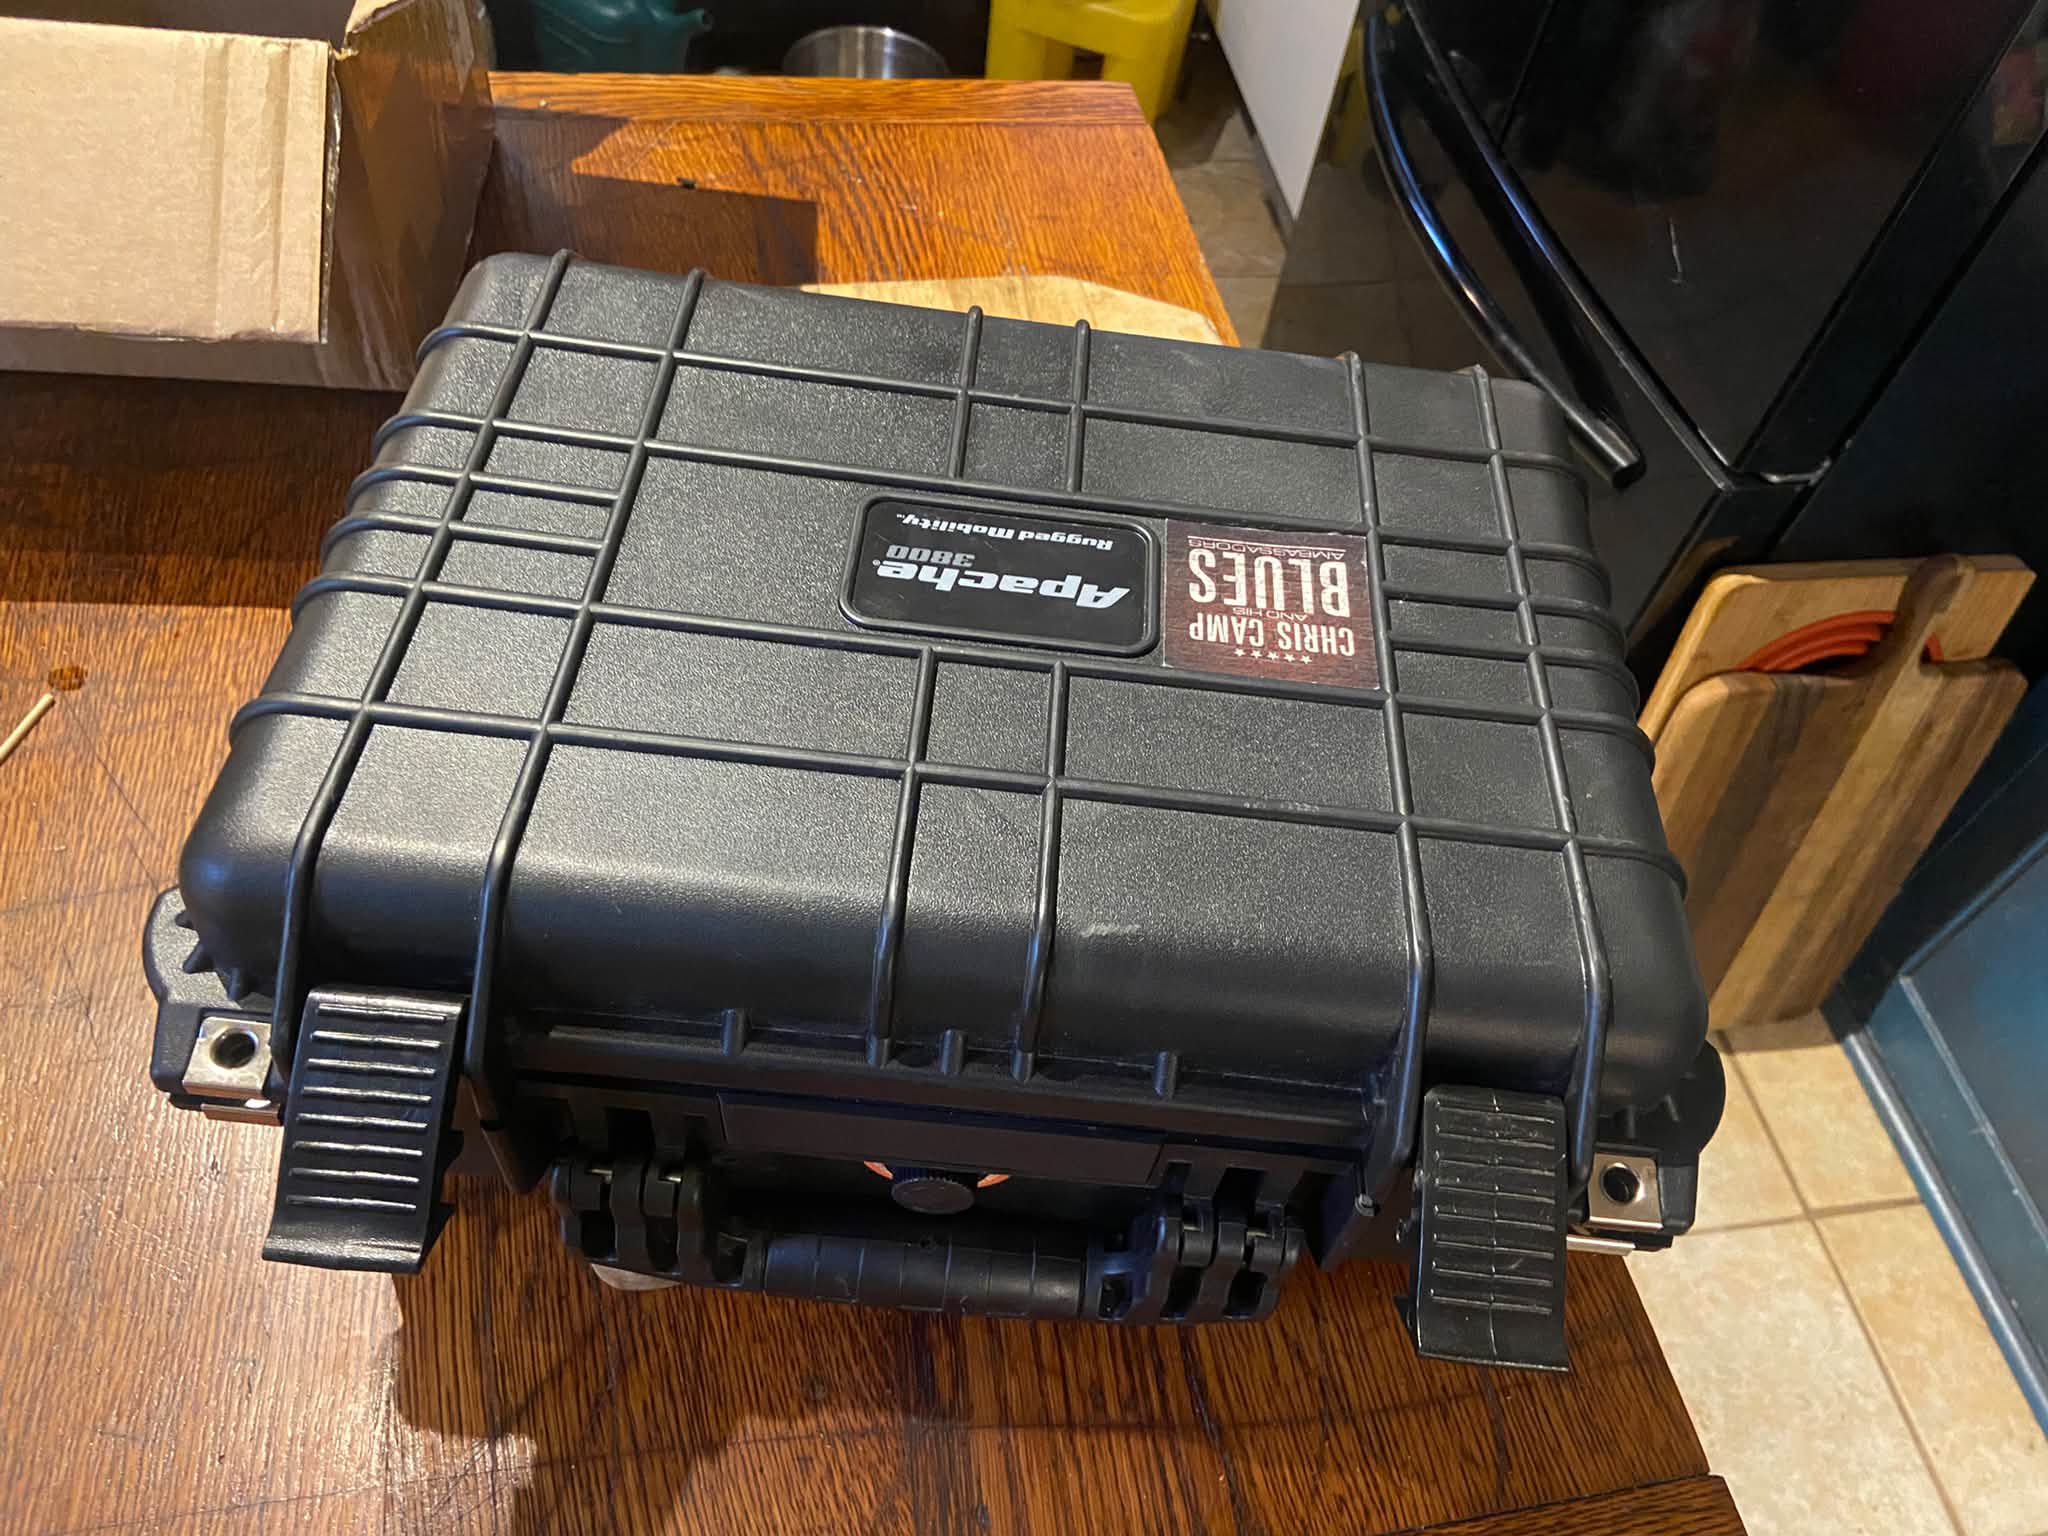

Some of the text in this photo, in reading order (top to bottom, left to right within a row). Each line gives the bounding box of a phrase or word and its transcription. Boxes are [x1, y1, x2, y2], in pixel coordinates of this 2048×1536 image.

[1018, 530, 1113, 551] Rugged
[1189, 539, 1345, 560] AMBASSADORS
[886, 545, 976, 567] 3800
[876, 560, 1130, 609] Apache
[1188, 549, 1351, 618] BLUES
[1232, 607, 1308, 622] AND HIS
[1188, 612, 1356, 657] CHRIS CAMP
